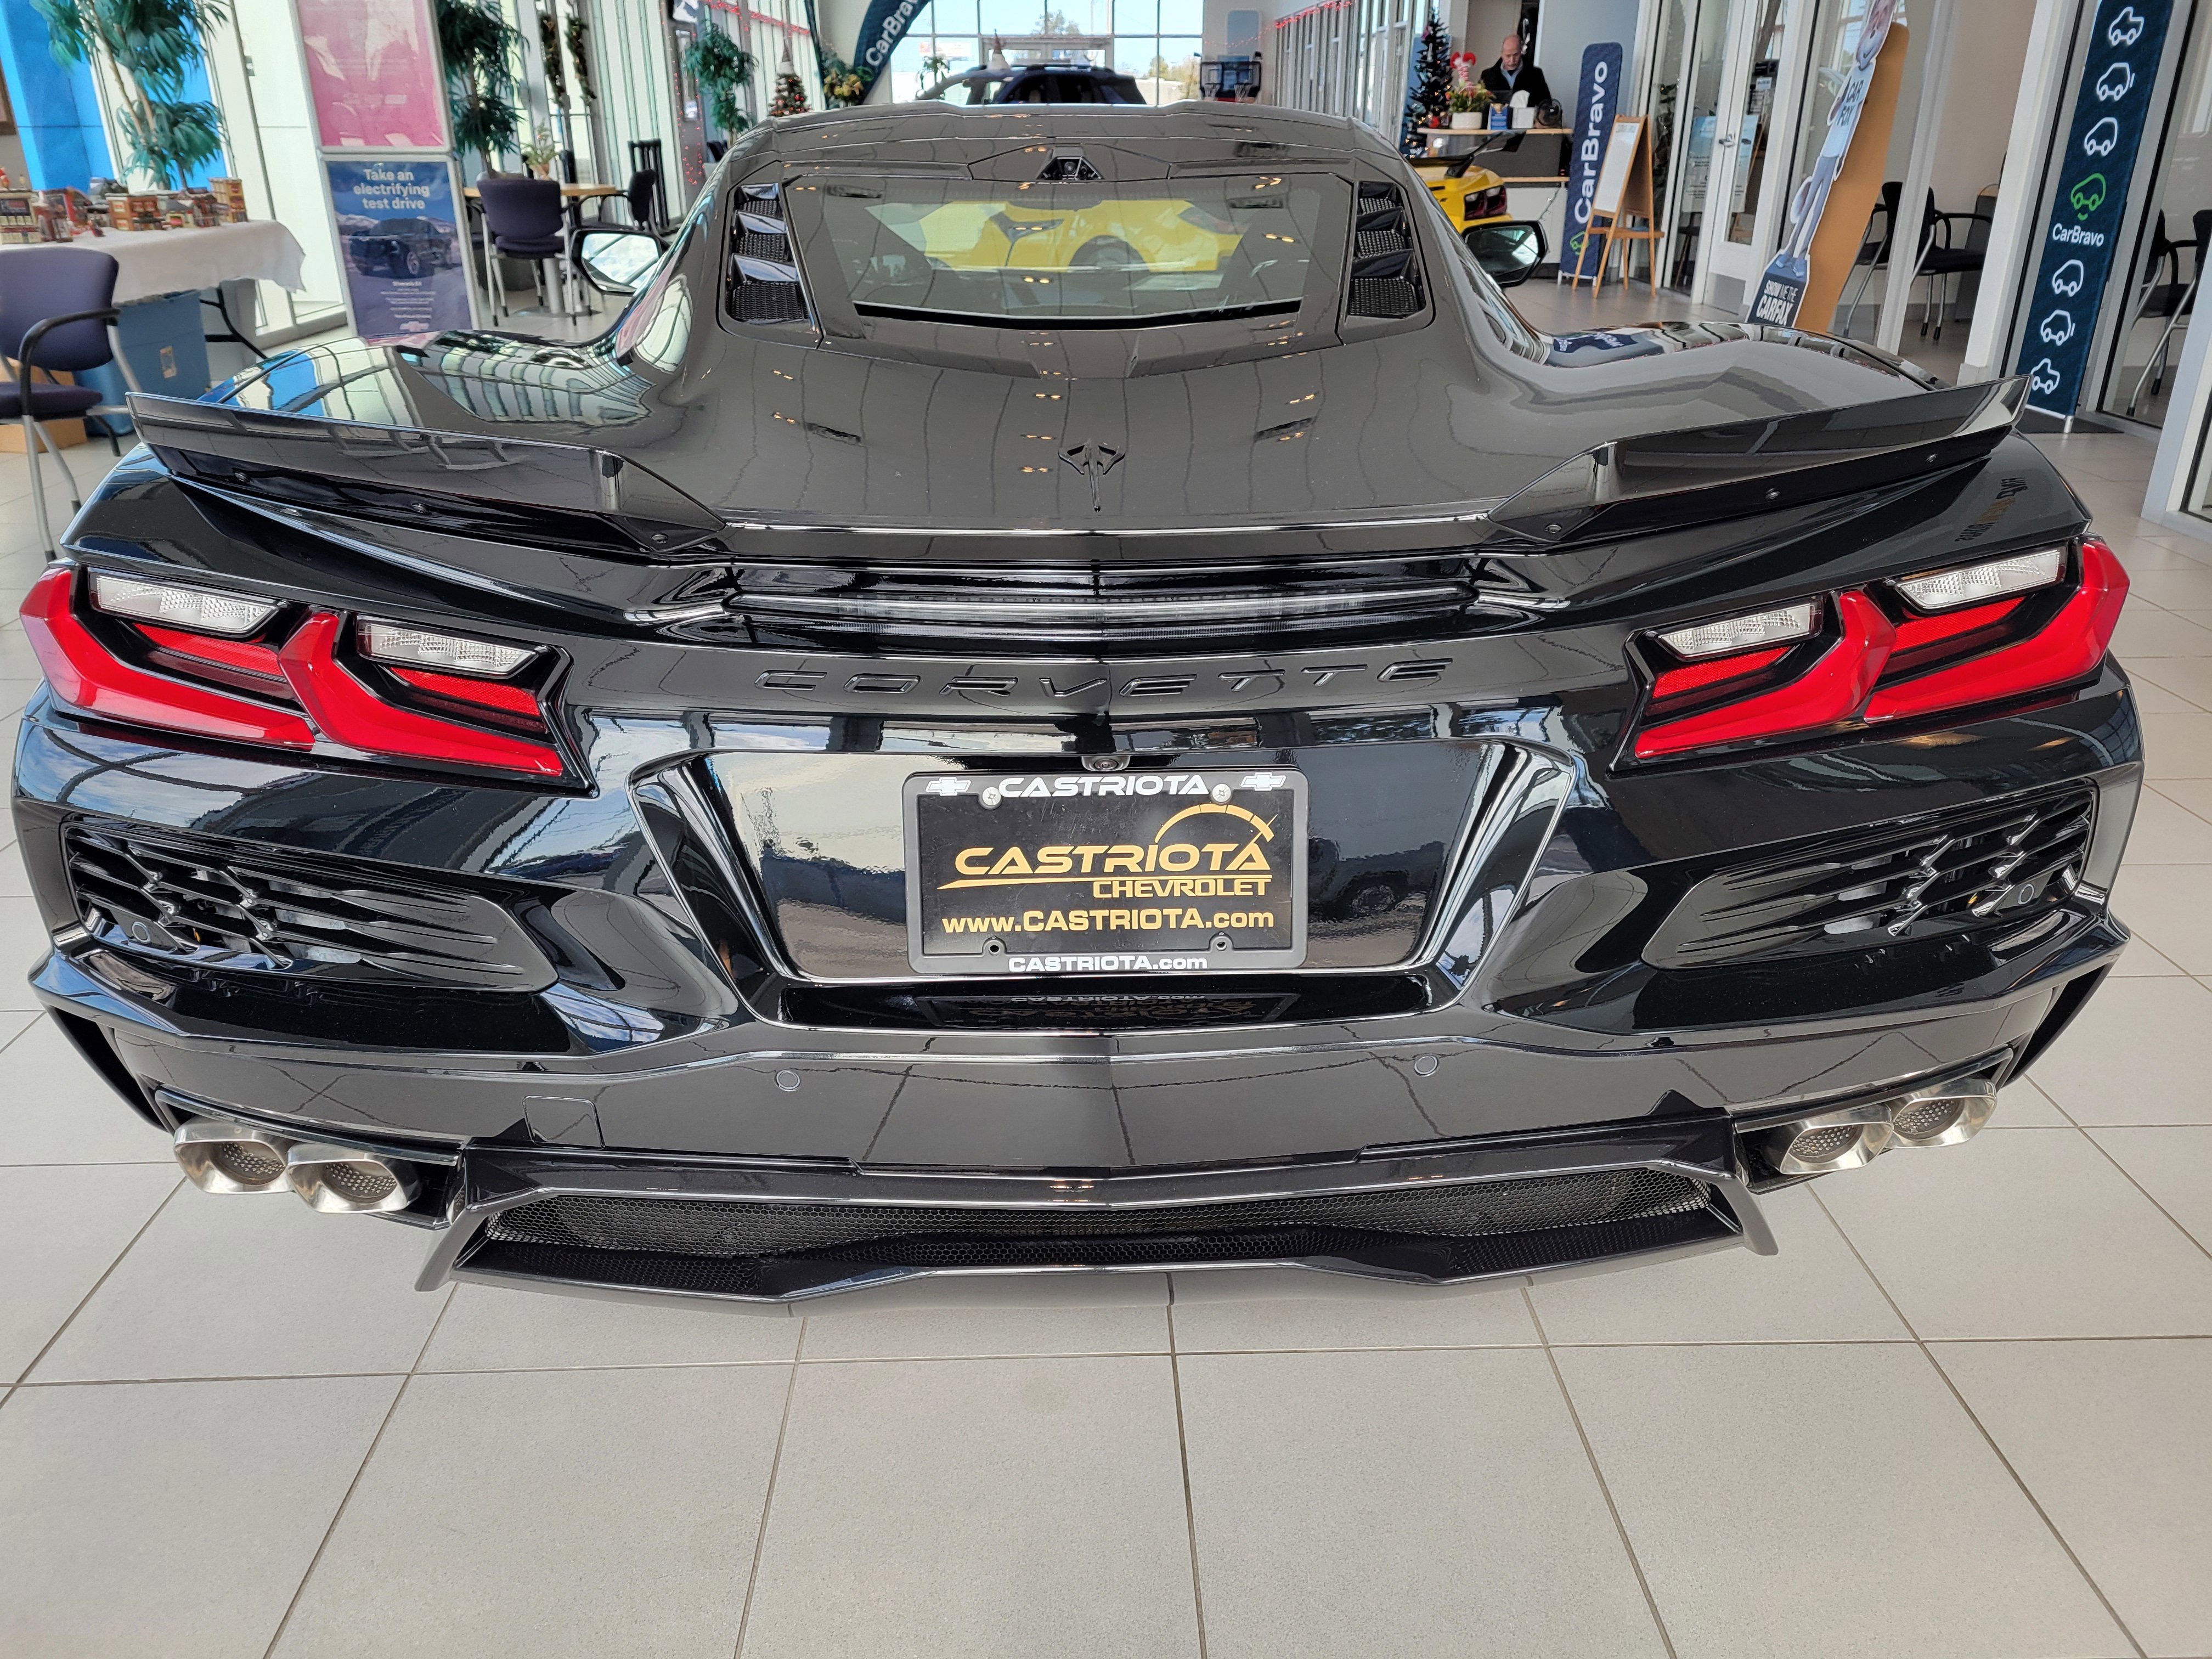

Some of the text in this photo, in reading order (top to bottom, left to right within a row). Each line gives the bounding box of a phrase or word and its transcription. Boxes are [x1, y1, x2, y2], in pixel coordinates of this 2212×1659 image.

[1846, 80, 1864, 103] CAR
[1836, 105, 1855, 127] FOX
[1574, 61, 1608, 224] CarBravo
[364, 168, 414, 181] Take an
[353, 183, 431, 198] electrifying
[362, 197, 426, 210] test drive
[2052, 223, 2104, 247] CarBravo
[1756, 294, 1793, 326] CARFAX
[754, 658, 1454, 697] CORVETTE
[998, 774, 1210, 798] CASTRIOTA
[955, 843, 1271, 875] CASTRIOTA
[1093, 878, 1272, 899] CHEVROLET
[941, 907, 1274, 933] www.CASTRIOTA.com
[1008, 955, 1207, 972] CASTRIOTA.com
